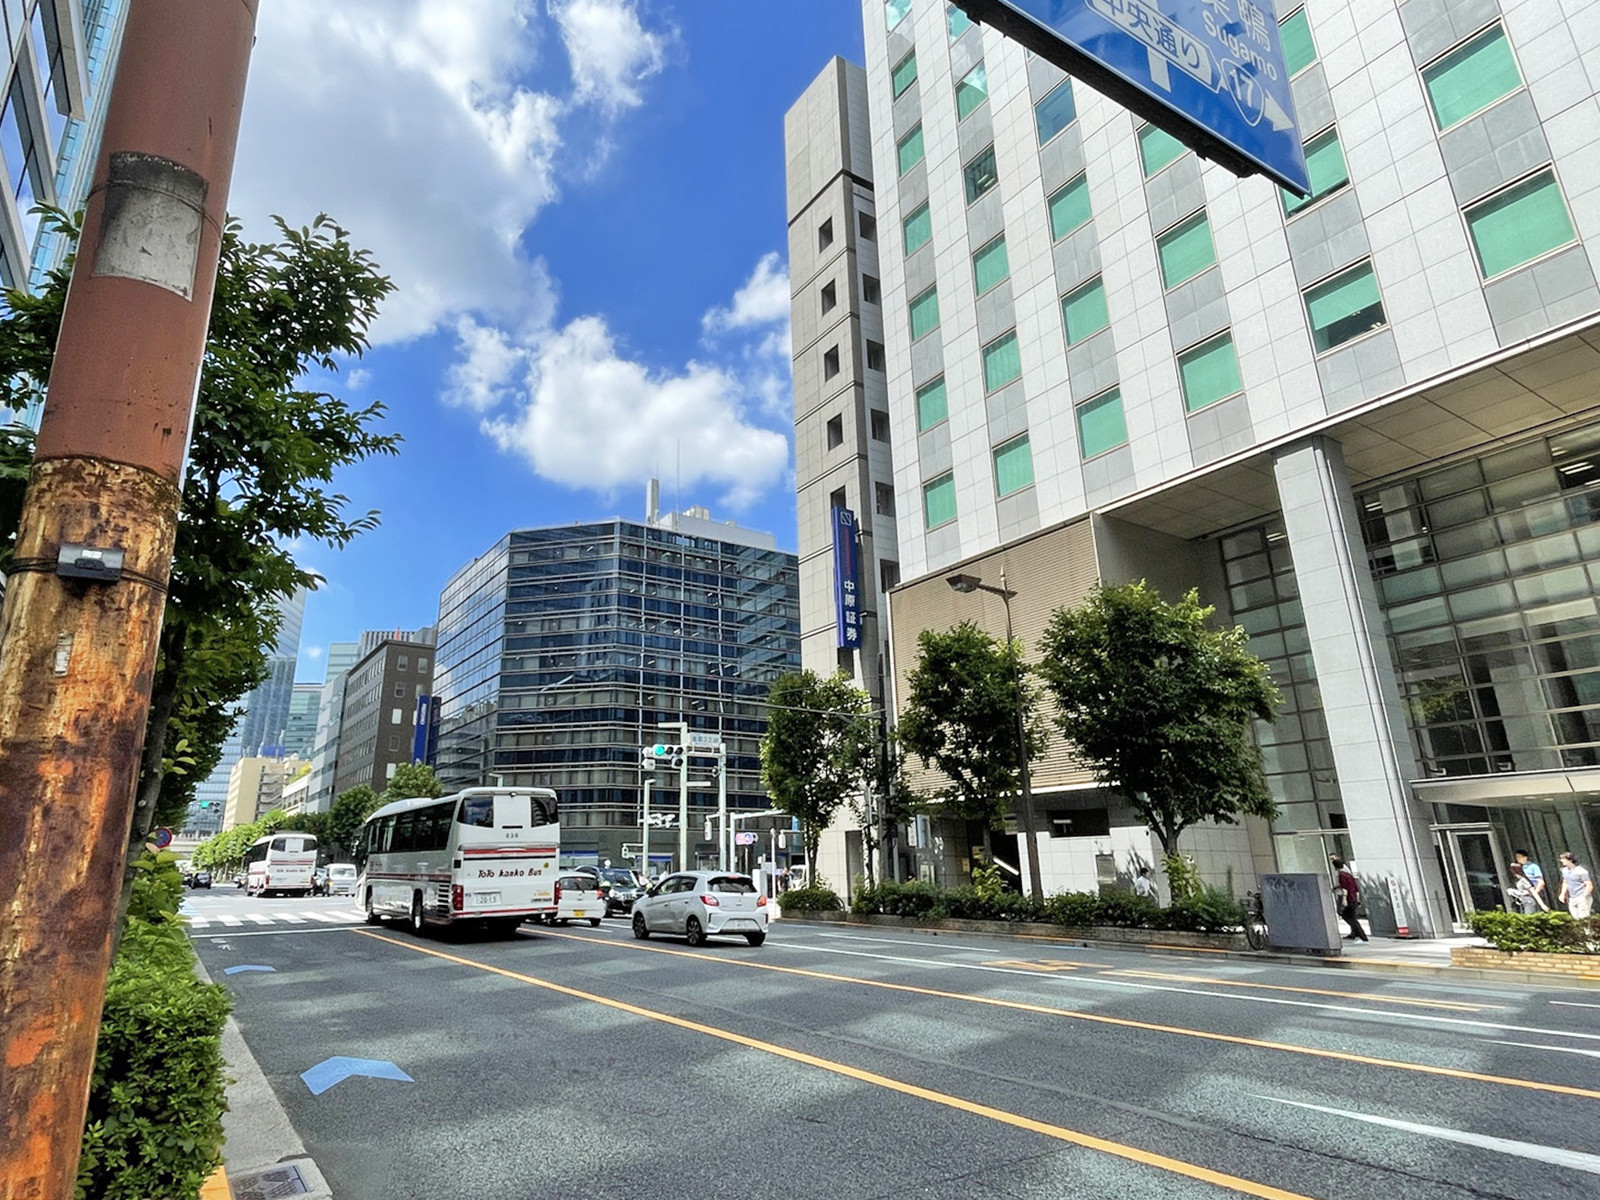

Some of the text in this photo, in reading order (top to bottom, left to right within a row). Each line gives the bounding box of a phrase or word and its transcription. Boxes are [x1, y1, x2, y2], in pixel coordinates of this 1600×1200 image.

[1202, 10, 1278, 81] Sugamo
[1230, 69, 1254, 108] 17
[478, 869, 495, 878] ToTo
[528, 868, 541, 876] Bus
